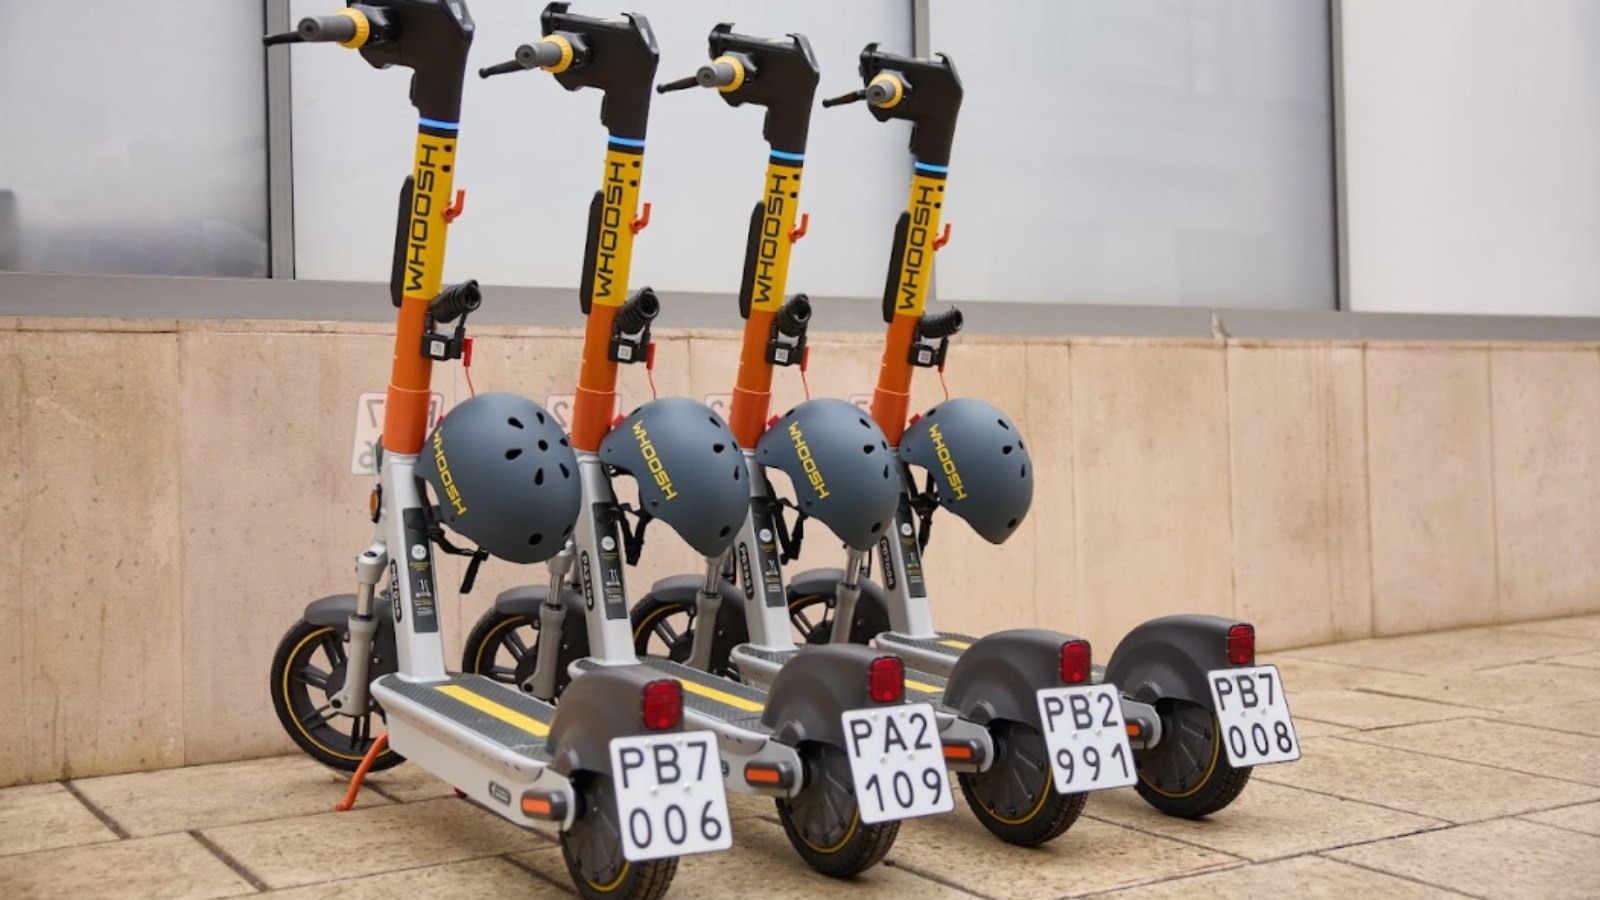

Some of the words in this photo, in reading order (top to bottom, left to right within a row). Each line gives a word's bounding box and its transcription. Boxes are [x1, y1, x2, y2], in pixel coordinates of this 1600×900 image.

[405, 144, 439, 291] WHOOSH
[595, 161, 626, 297] WHOOSH
[754, 173, 787, 303] WHOOSH
[898, 185, 934, 310] WHOOSH
[433, 427, 467, 515] WHOOSH
[633, 420, 677, 501] WHOOSH
[788, 421, 829, 499] WHOOSH
[928, 423, 967, 500] WHOOSH
[1044, 692, 1119, 732] PB2
[1214, 673, 1273, 711] PB7
[619, 741, 707, 789] PB7
[849, 712, 932, 758] PA2
[1056, 743, 1129, 784] 991
[1228, 720, 1293, 759] 008
[866, 767, 942, 812] 109
[629, 801, 722, 849] 006
